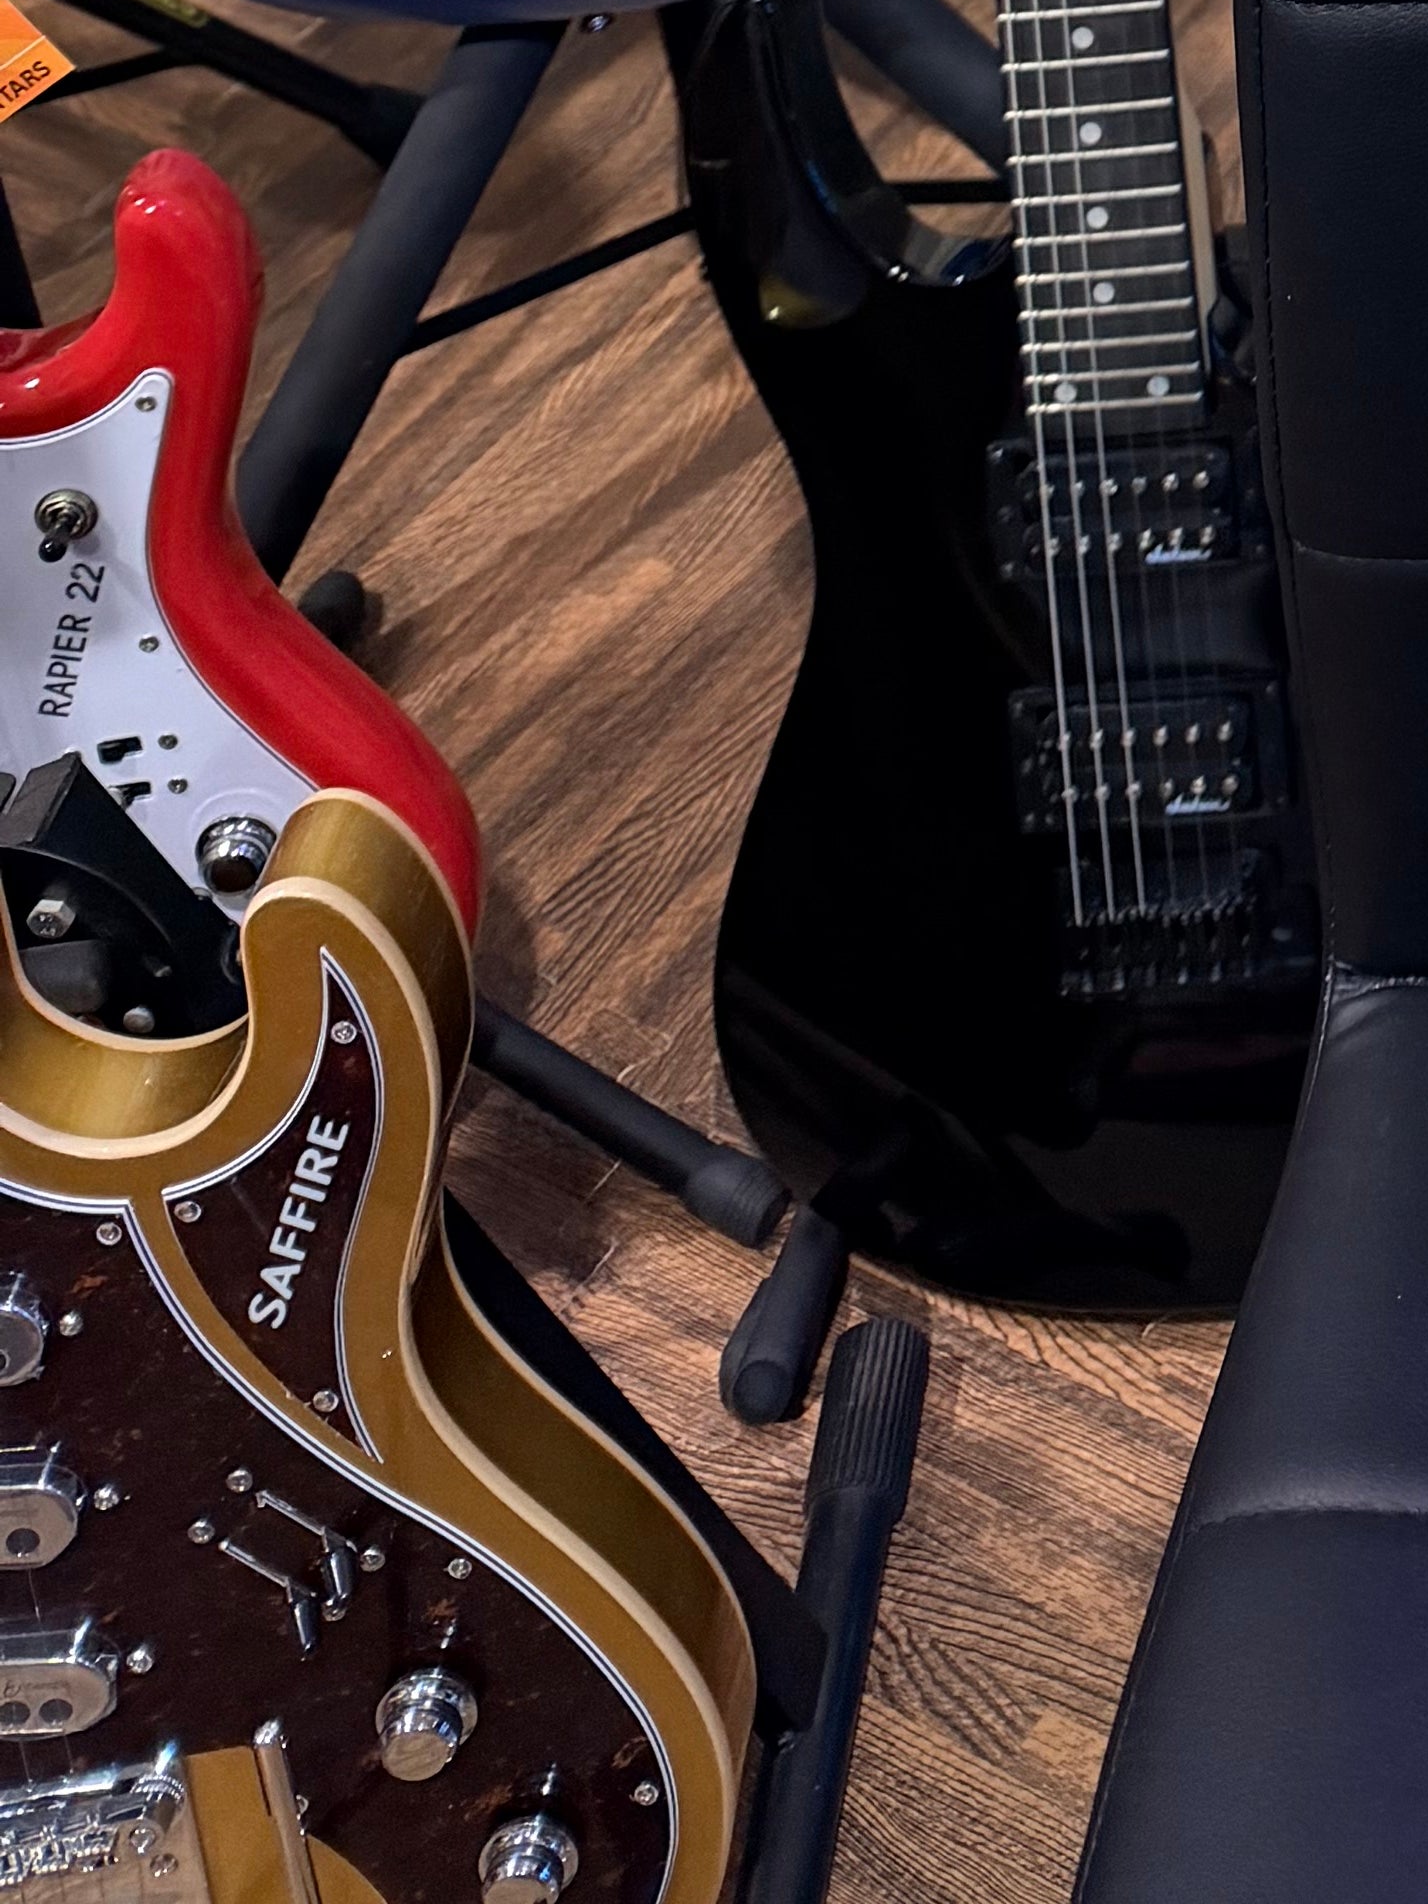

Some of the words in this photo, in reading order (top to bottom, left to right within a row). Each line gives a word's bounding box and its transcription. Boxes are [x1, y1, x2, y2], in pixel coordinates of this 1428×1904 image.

[65, 560, 105, 605] 22
[38, 610, 93, 719] RAPIER
[246, 1113, 352, 1330] SAFFIRE
